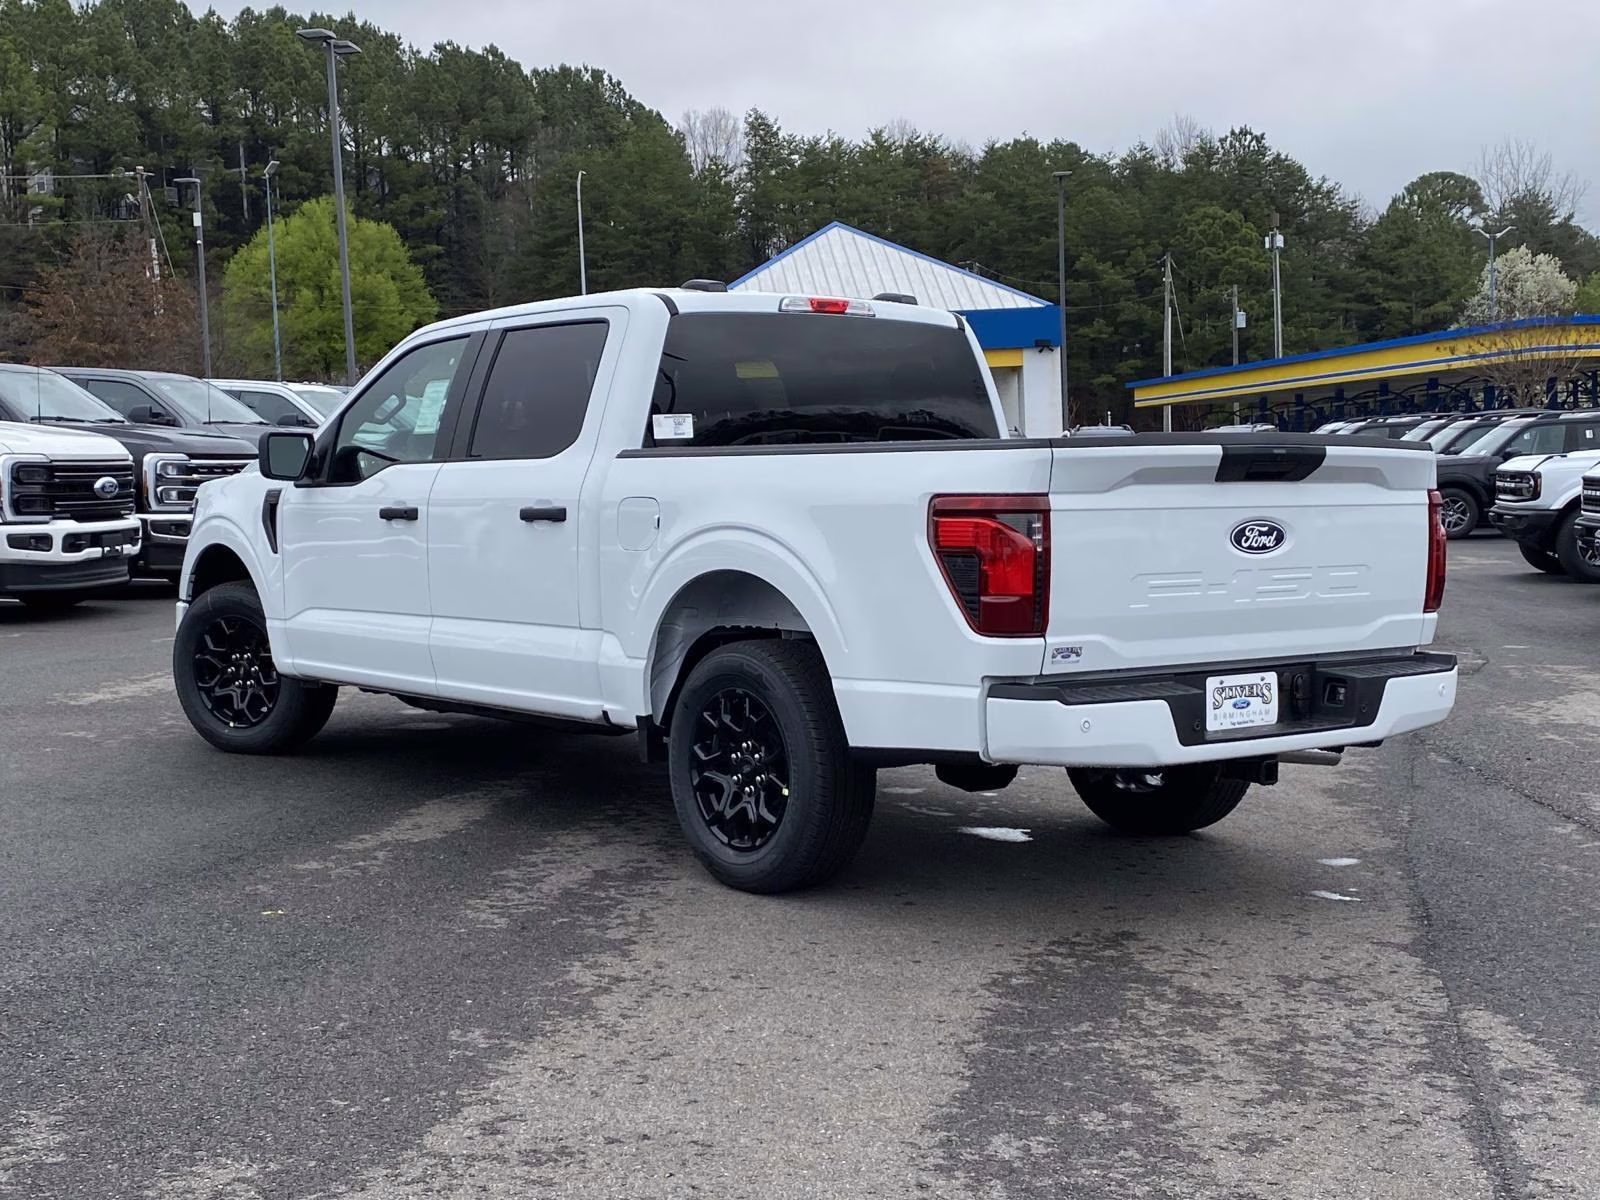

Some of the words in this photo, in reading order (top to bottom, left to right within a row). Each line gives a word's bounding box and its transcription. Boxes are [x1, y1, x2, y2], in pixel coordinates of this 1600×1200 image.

[1241, 525, 1277, 548] Ford
[1213, 683, 1272, 710] STIVERS
[1213, 709, 1271, 721] BIRMINGHAM
